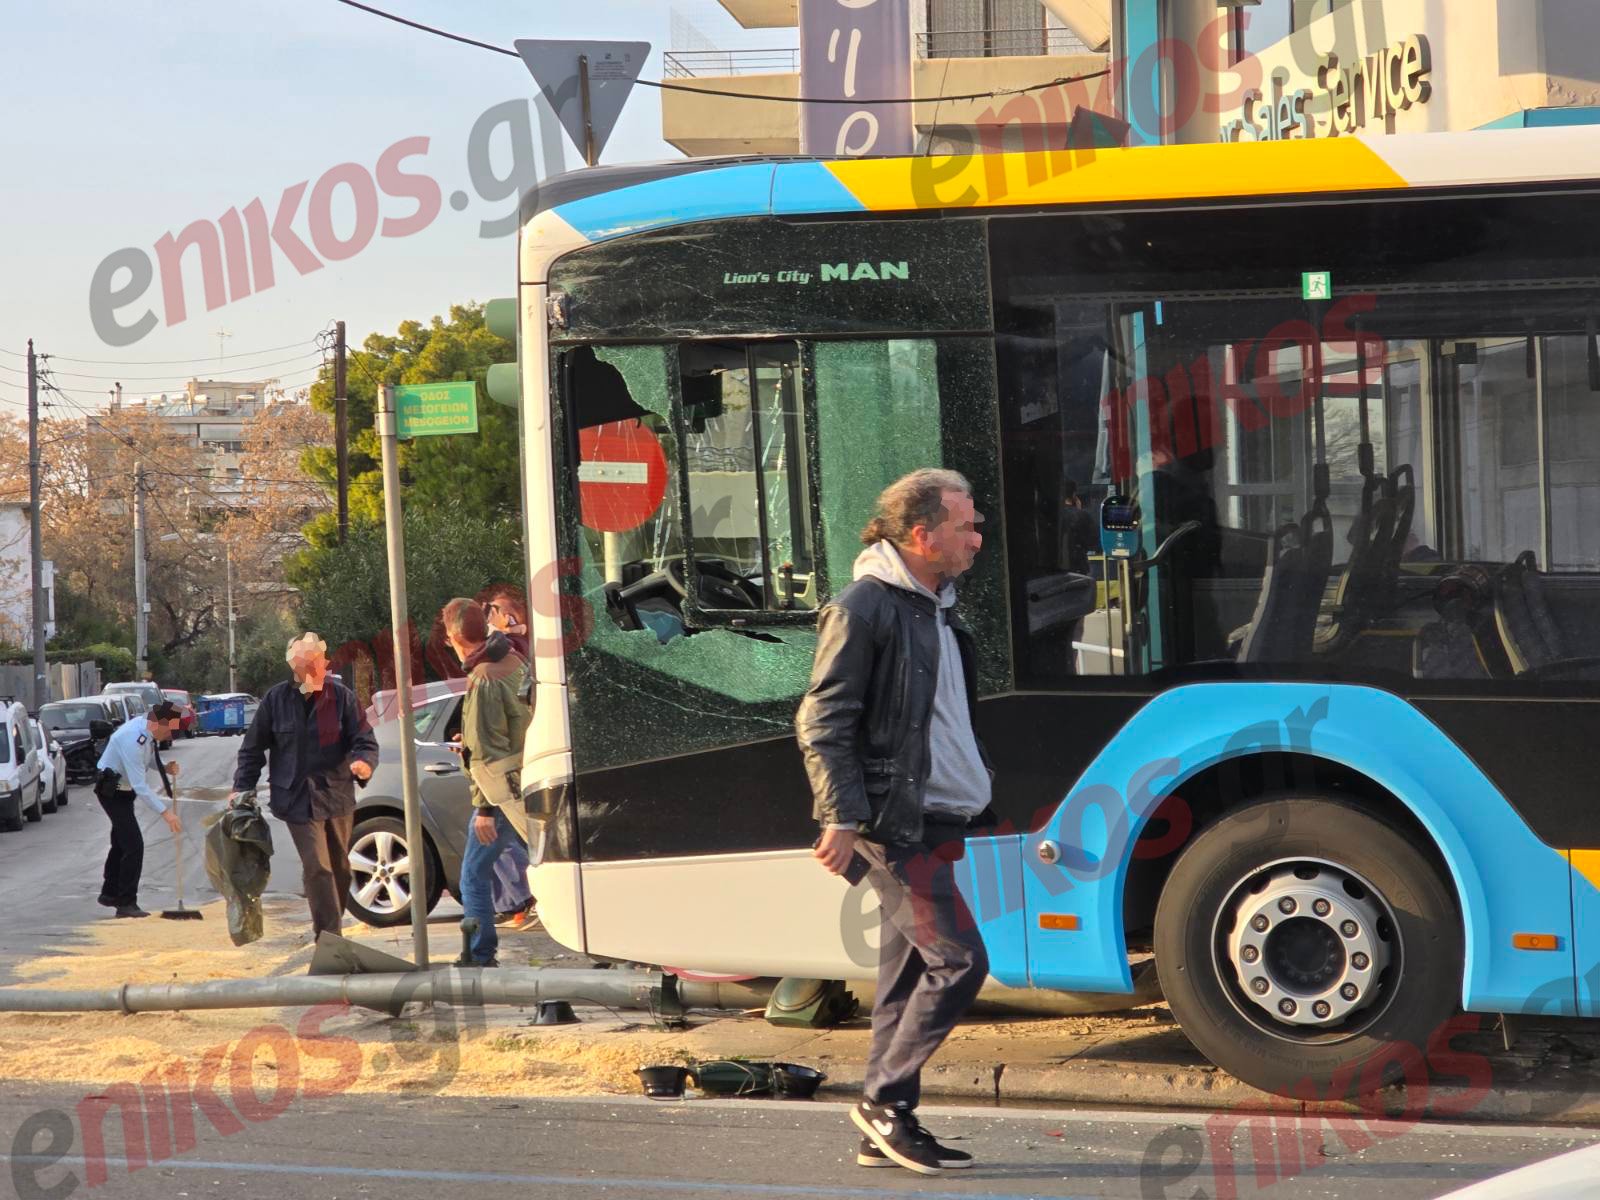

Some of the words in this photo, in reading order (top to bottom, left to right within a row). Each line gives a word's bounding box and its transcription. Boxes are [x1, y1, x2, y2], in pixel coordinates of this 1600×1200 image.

[723, 271, 770, 284] Lion's
[777, 270, 811, 285] City
[820, 261, 909, 281] MAN
